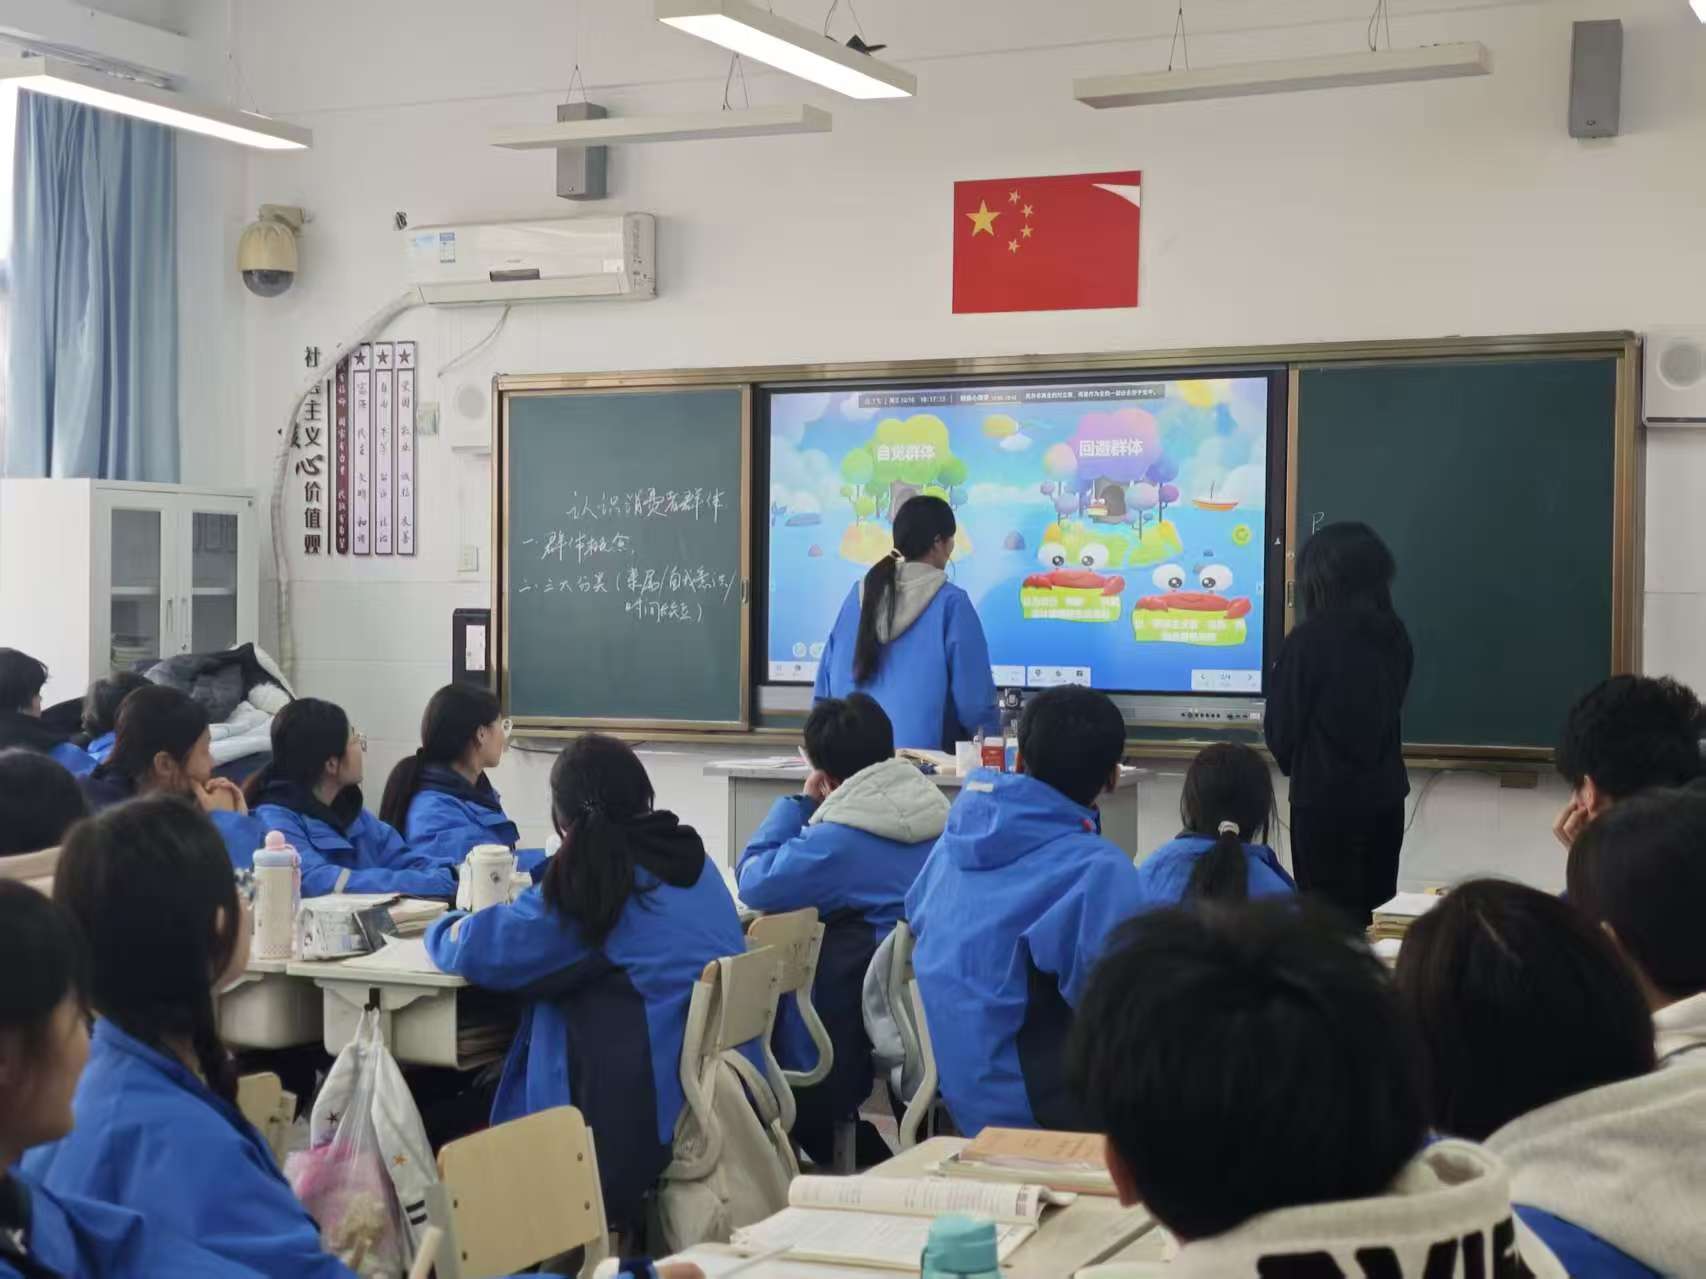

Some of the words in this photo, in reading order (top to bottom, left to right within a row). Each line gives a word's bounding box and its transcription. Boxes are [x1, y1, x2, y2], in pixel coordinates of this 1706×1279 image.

[1079, 438, 1144, 457] 回避群体
[565, 487, 727, 524] 认识消费者群体
